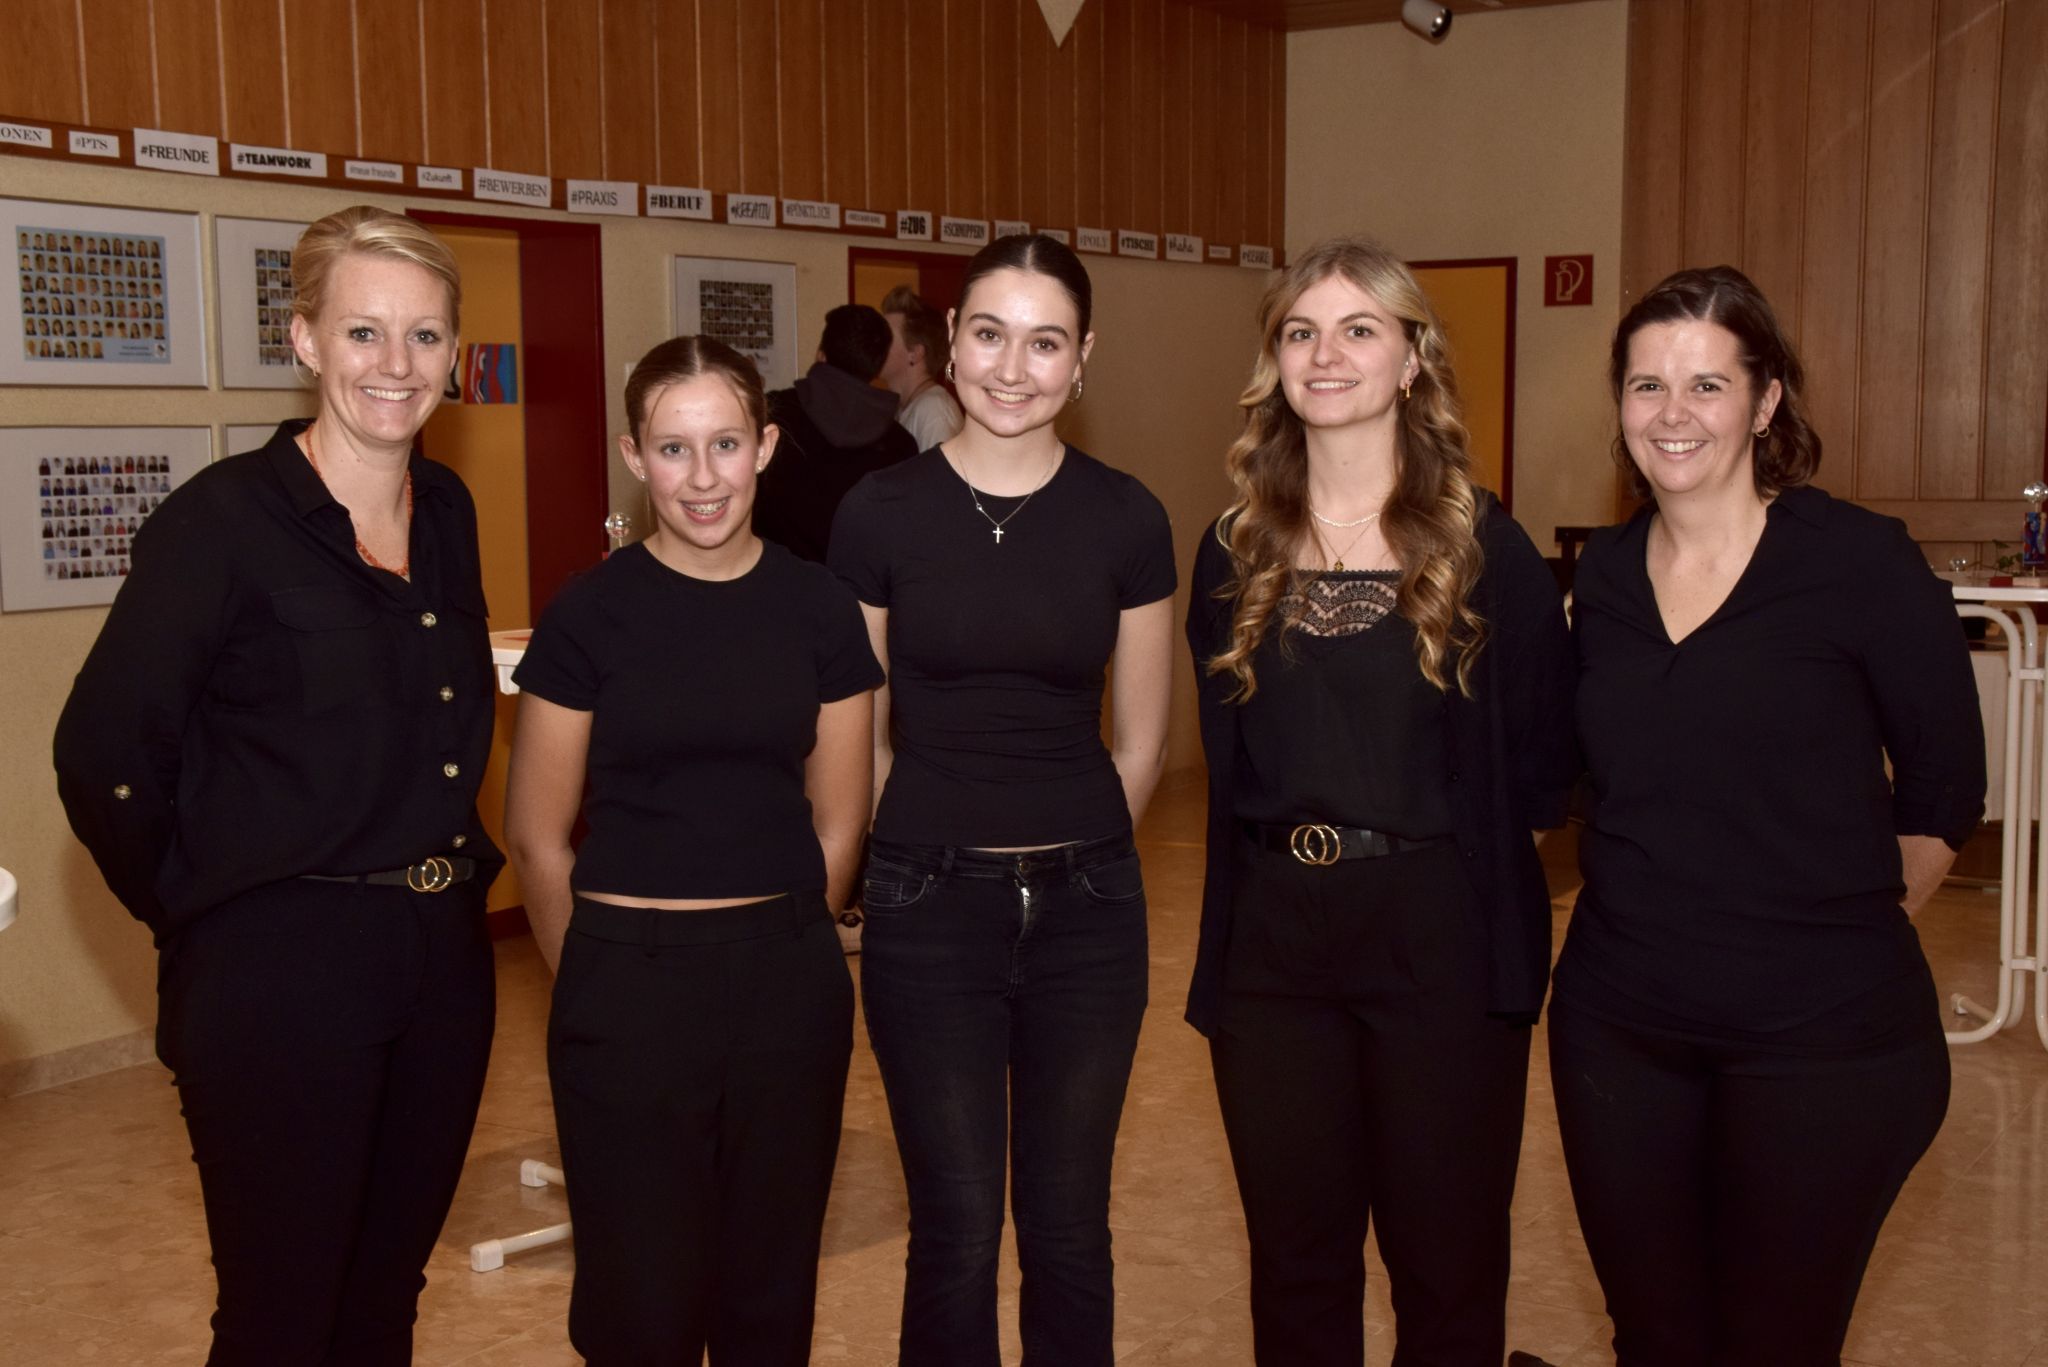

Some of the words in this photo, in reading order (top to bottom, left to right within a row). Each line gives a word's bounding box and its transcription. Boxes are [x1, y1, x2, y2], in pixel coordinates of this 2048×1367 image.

[75, 136, 108, 150] #PTS
[140, 144, 210, 164] #FREUNDE
[237, 152, 312, 169] #TEAMWORK
[421, 171, 453, 184] #Zukunft
[478, 176, 548, 198] #BEWERBEN
[571, 190, 618, 206] #PRAXIS
[650, 192, 704, 210] #BERUF
[900, 215, 926, 235] #ZUG
[1079, 234, 1108, 248] #POLY
[1121, 236, 1155, 252] #TISCHE
